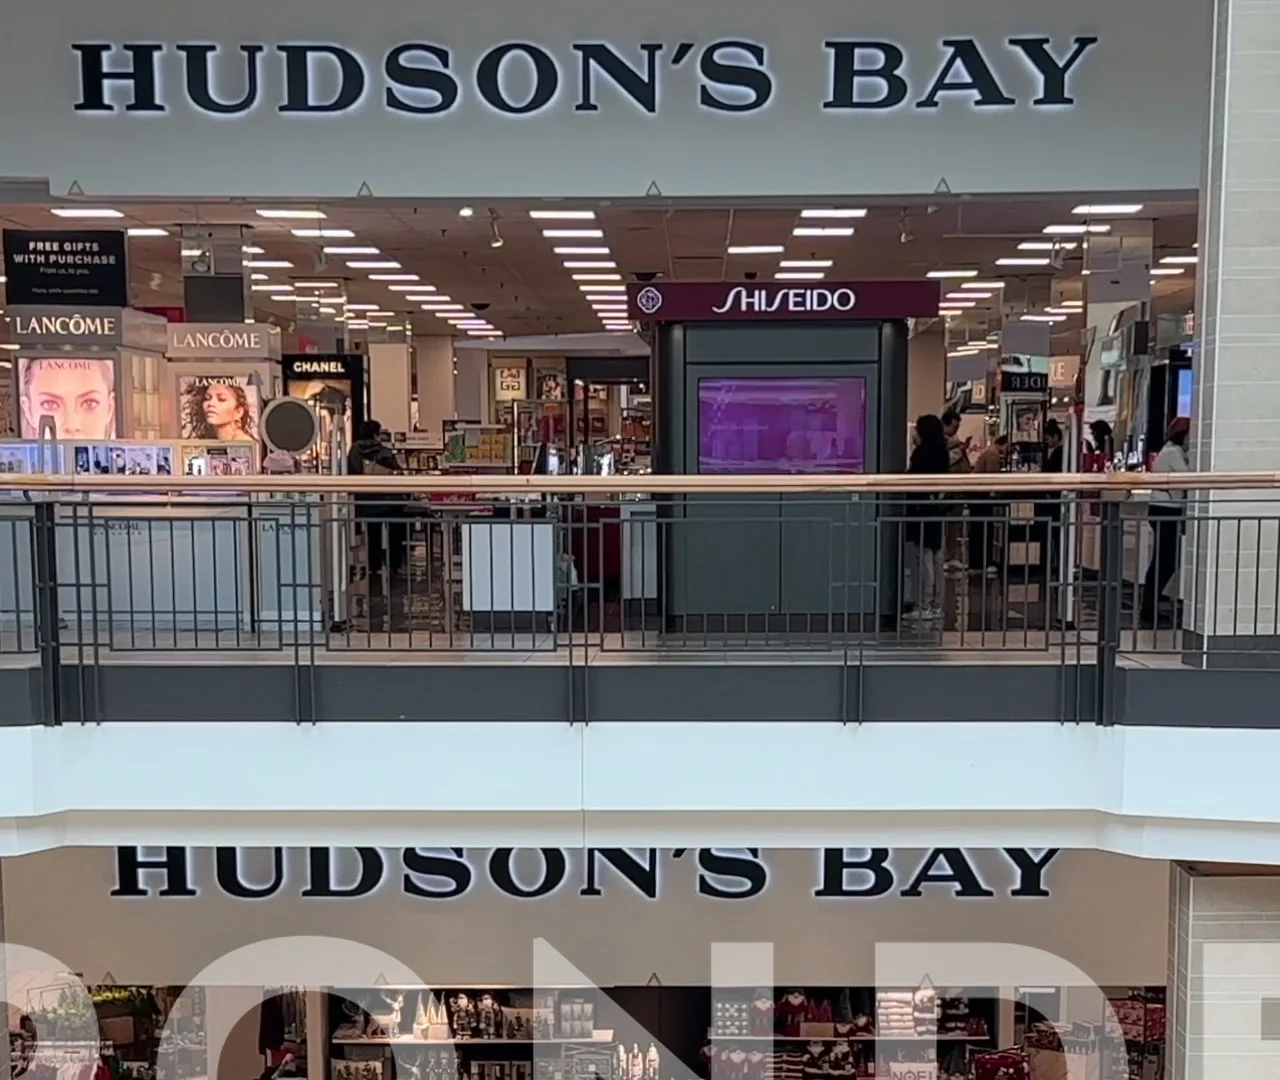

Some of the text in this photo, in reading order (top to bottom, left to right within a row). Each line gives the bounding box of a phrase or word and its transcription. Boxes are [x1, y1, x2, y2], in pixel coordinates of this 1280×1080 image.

[70, 35, 1098, 115] HUDSON'S BAY
[28, 241, 99, 252] FREE GIFTS
[13, 254, 116, 265] WITH PURCHASE
[711, 287, 857, 313] SHISEIDO
[16, 314, 117, 335] LANCÔME
[173, 329, 261, 349] LANCÔME
[293, 361, 346, 373] CHANEL
[813, 846, 1061, 898] BAY
